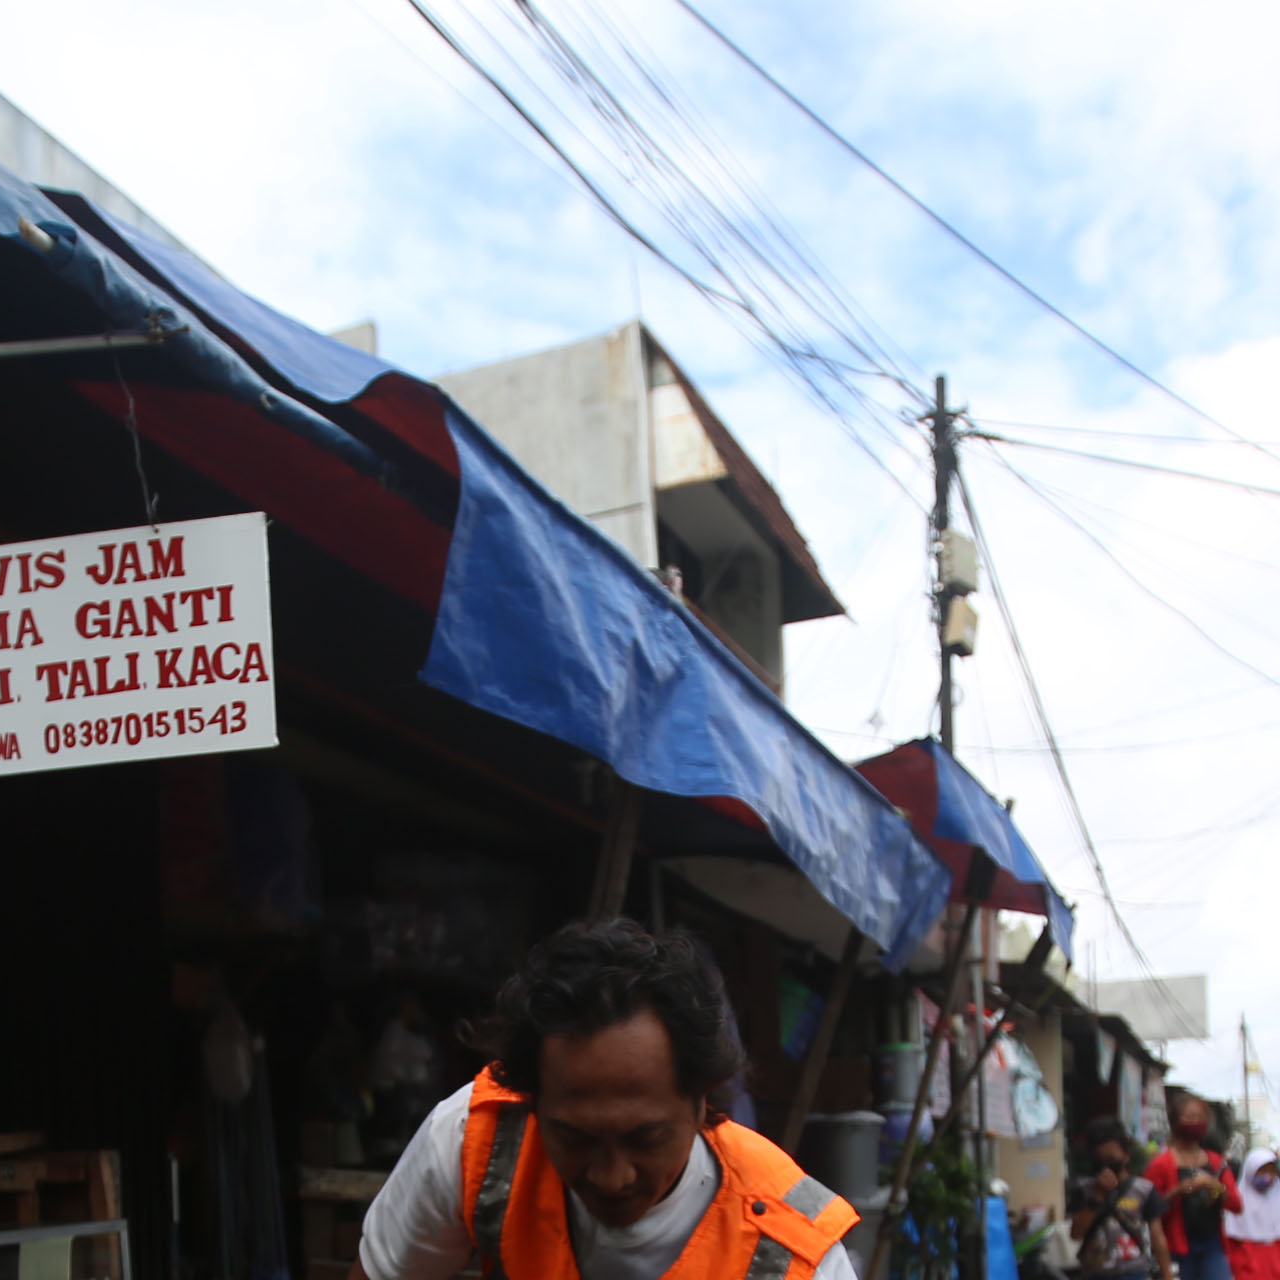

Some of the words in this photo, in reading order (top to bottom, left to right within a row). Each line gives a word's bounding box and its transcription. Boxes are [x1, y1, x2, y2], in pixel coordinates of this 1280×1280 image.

[86, 536, 185, 585] JAM
[75, 585, 234, 639] GANTI
[154, 642, 269, 688] KACA
[44, 701, 247, 754] 083870151543
